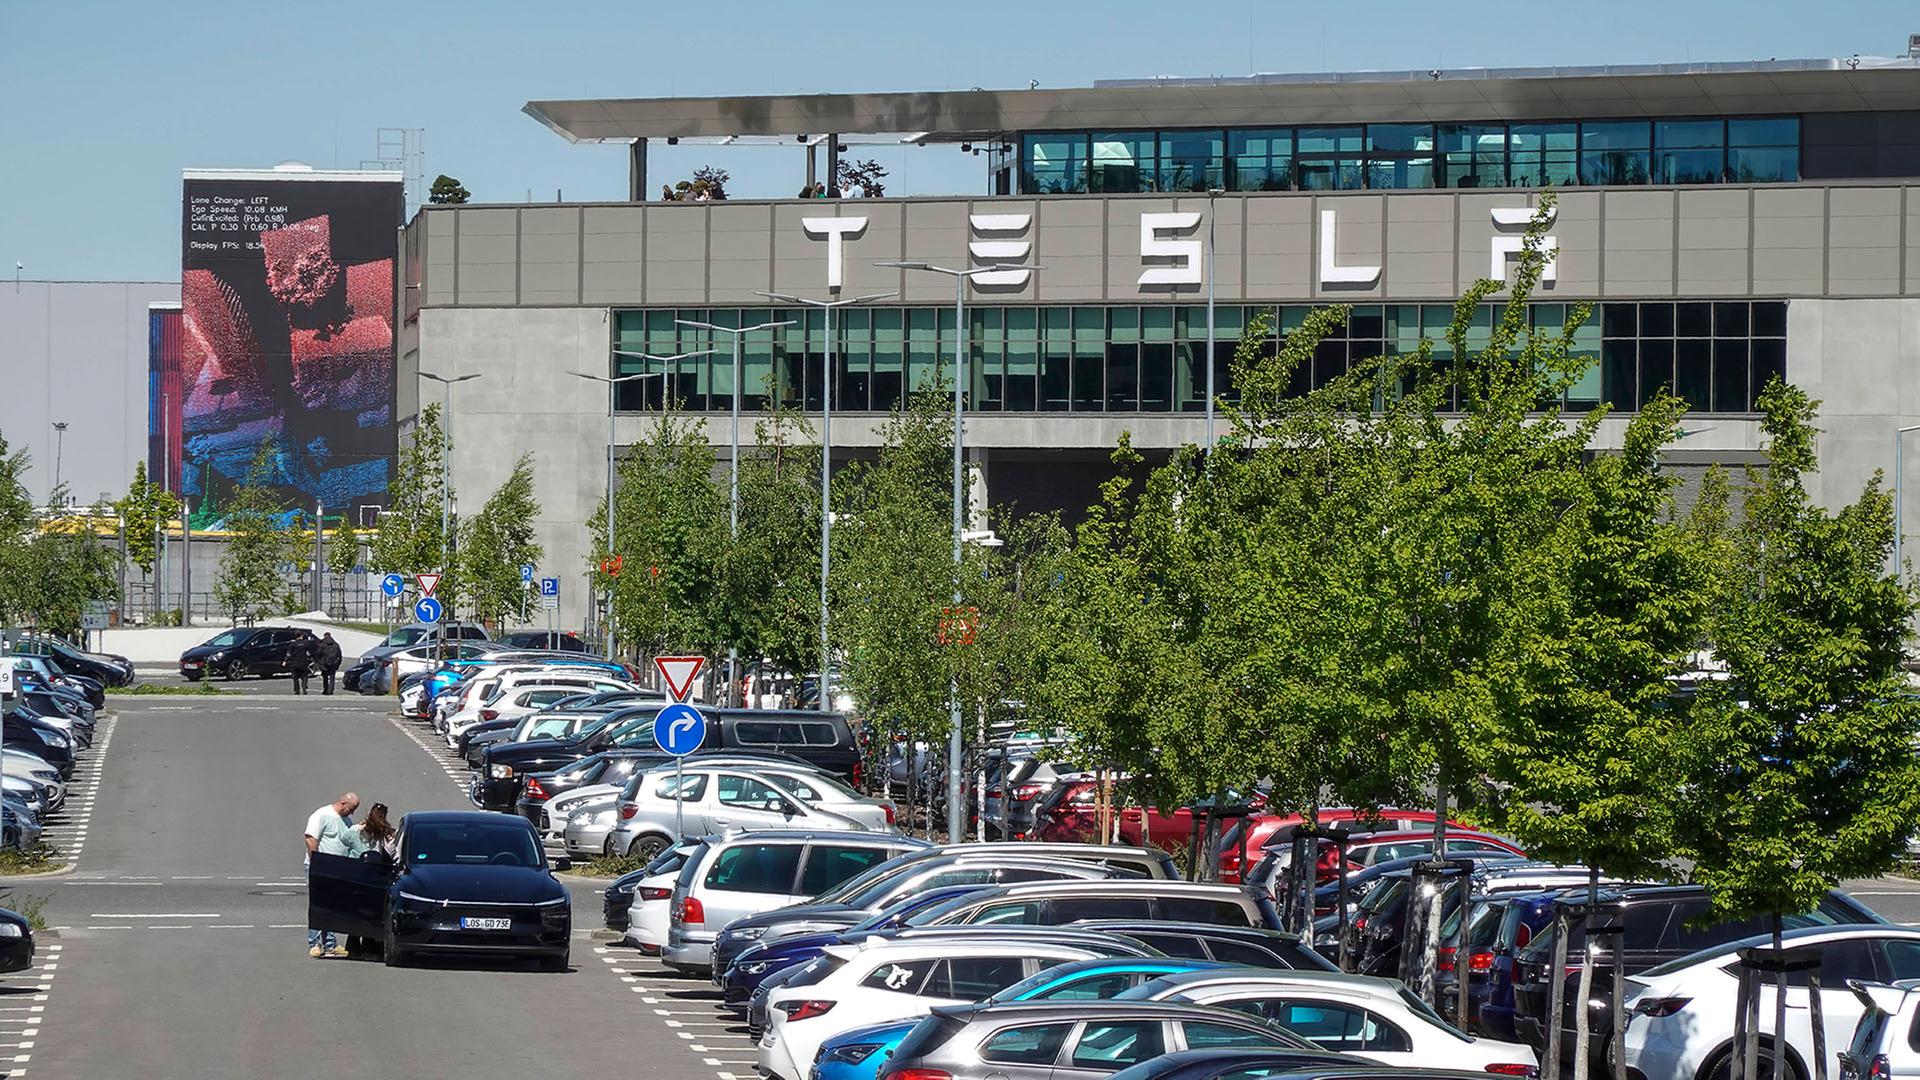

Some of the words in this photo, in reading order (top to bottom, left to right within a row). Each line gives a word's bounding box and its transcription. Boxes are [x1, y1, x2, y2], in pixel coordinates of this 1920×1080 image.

[190, 196, 210, 204] Lane
[213, 196, 245, 206] Change:
[250, 196, 269, 204] LEFT
[220, 223, 239, 231] 0.30
[243, 223, 248, 231] Y
[250, 223, 269, 231] 0.60
[272, 223, 278, 231] R
[190, 241, 218, 250] Display
[222, 241, 240, 249] FPS:
[801, 206, 1558, 288] TESLA
[465, 919, 480, 928] LOS
